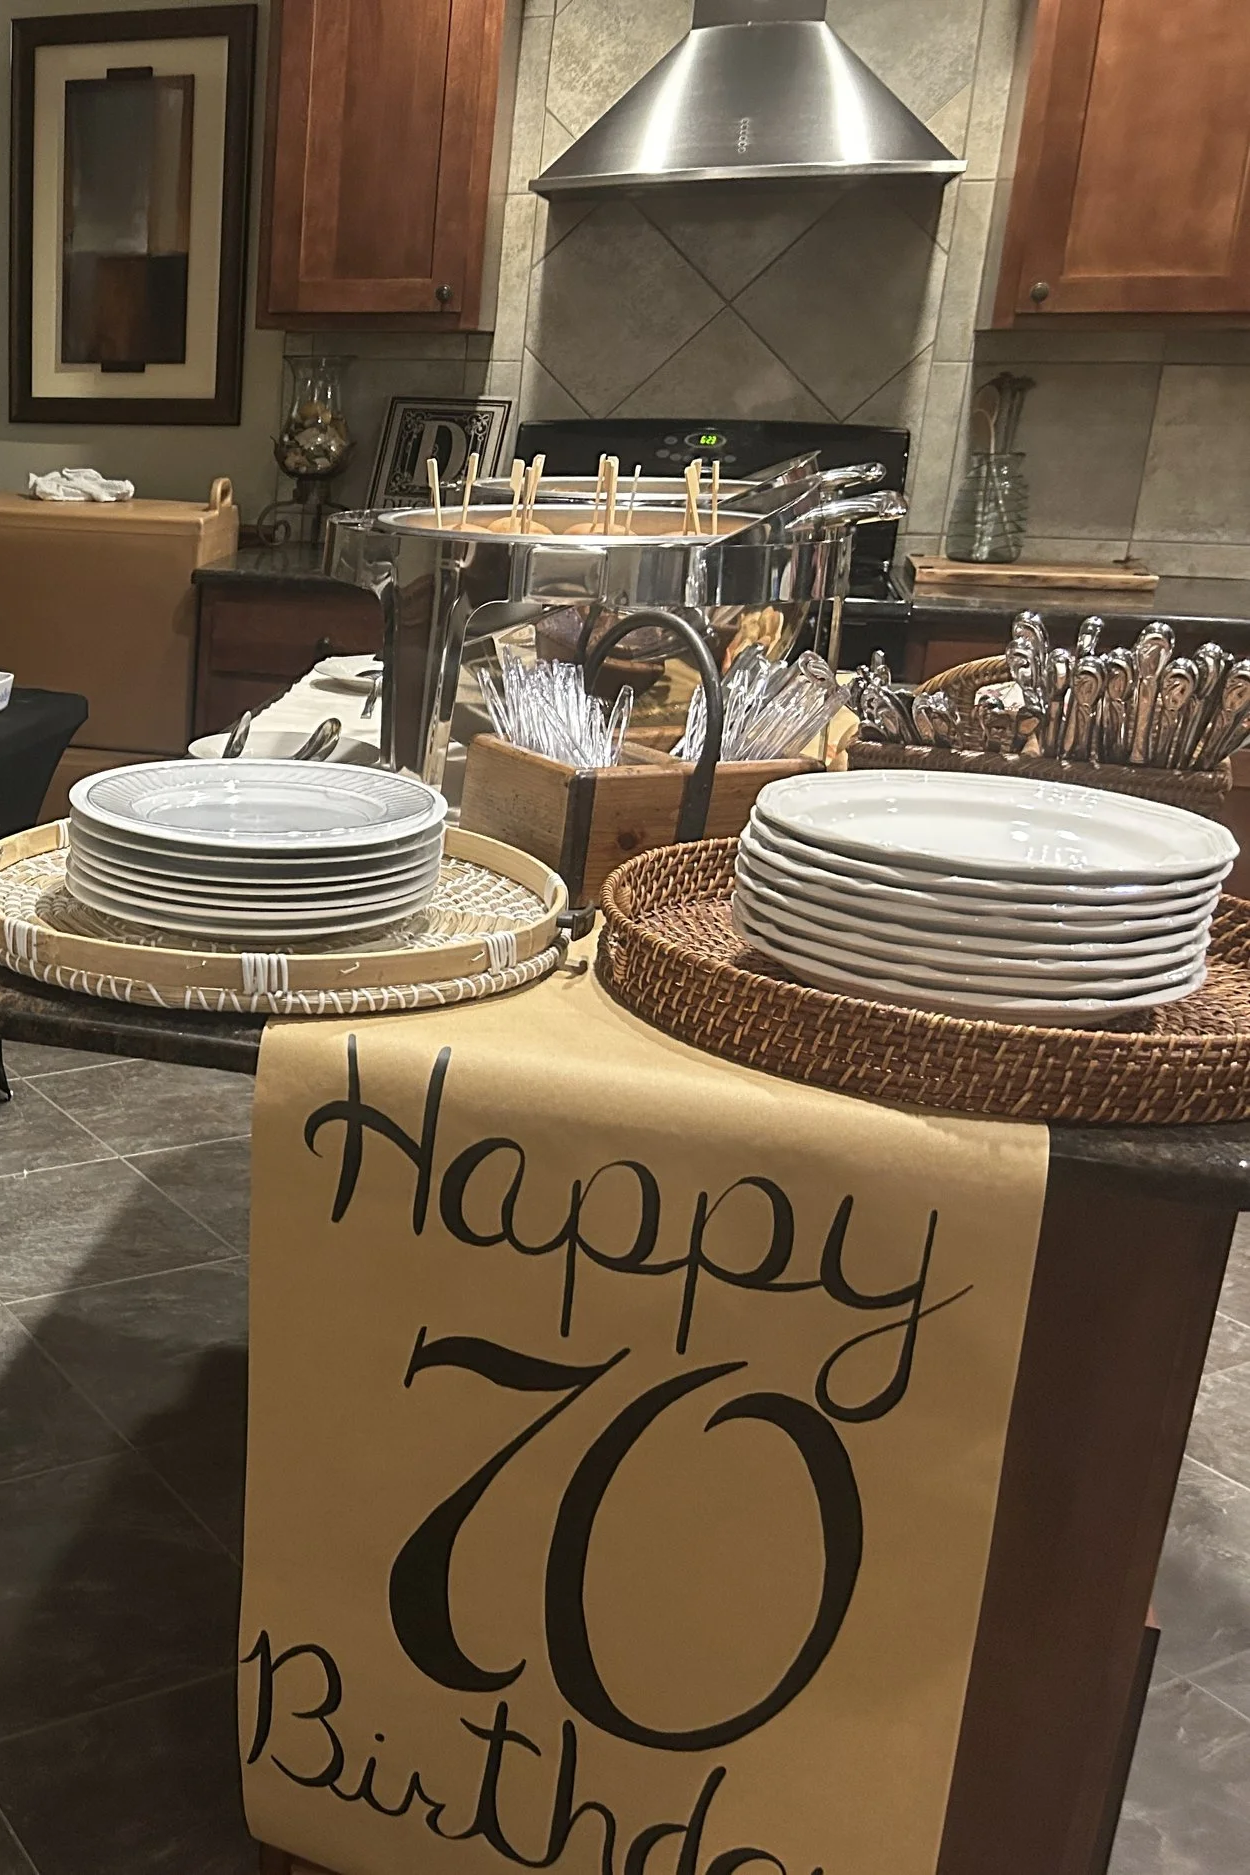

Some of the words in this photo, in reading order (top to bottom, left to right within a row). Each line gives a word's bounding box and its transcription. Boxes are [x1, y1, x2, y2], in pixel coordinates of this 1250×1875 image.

[303, 1032, 974, 1423] Happy
[387, 1325, 864, 1752] 70
[240, 1629, 824, 1875] Birthd
